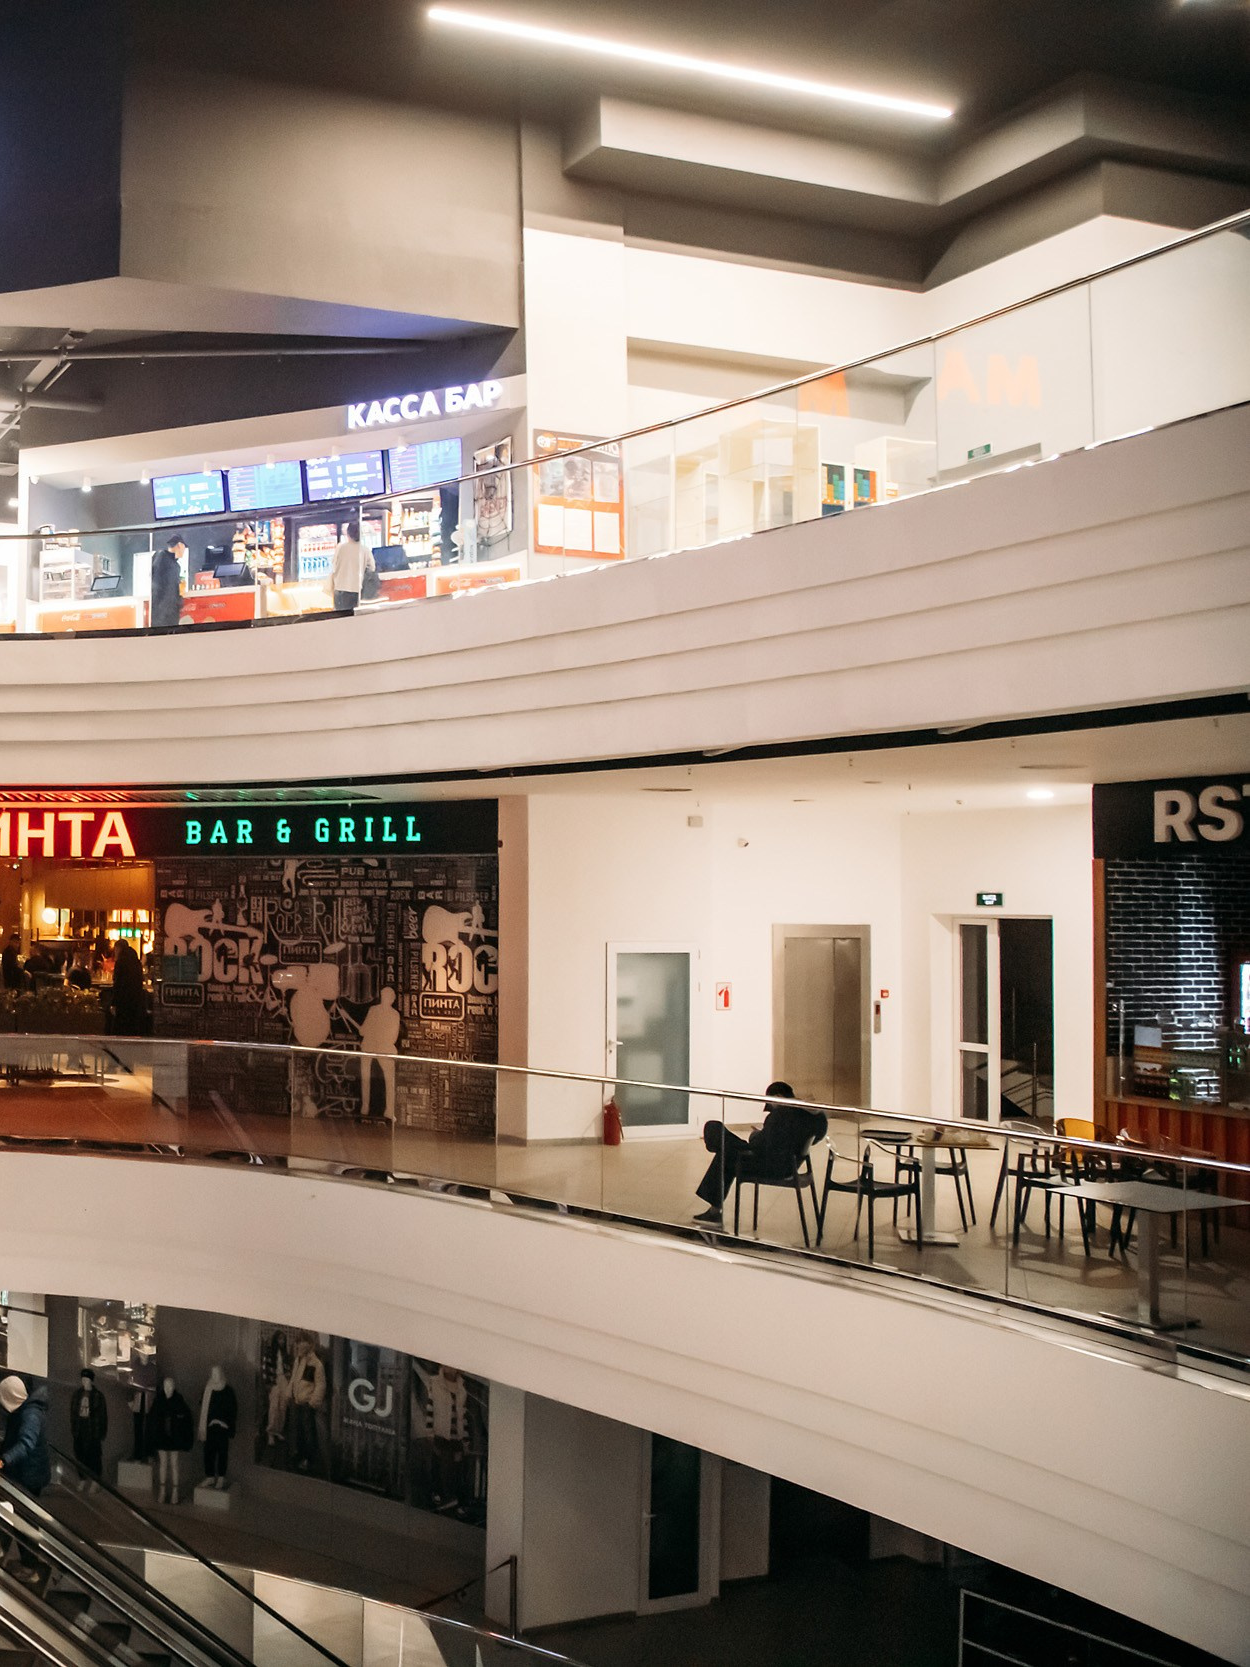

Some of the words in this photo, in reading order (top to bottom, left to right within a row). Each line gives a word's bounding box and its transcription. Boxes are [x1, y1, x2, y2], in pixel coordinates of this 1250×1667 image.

[347, 391, 442, 429] КАССА
[445, 381, 504, 413] БАР
[186, 819, 253, 845] BAR
[276, 818, 292, 844] &
[315, 816, 422, 844] GRILL
[1153, 784, 1250, 843] RS
[340, 867, 366, 877] PUB
[423, 997, 461, 1009] ПИНТА
[348, 1378, 393, 1418] GJ
